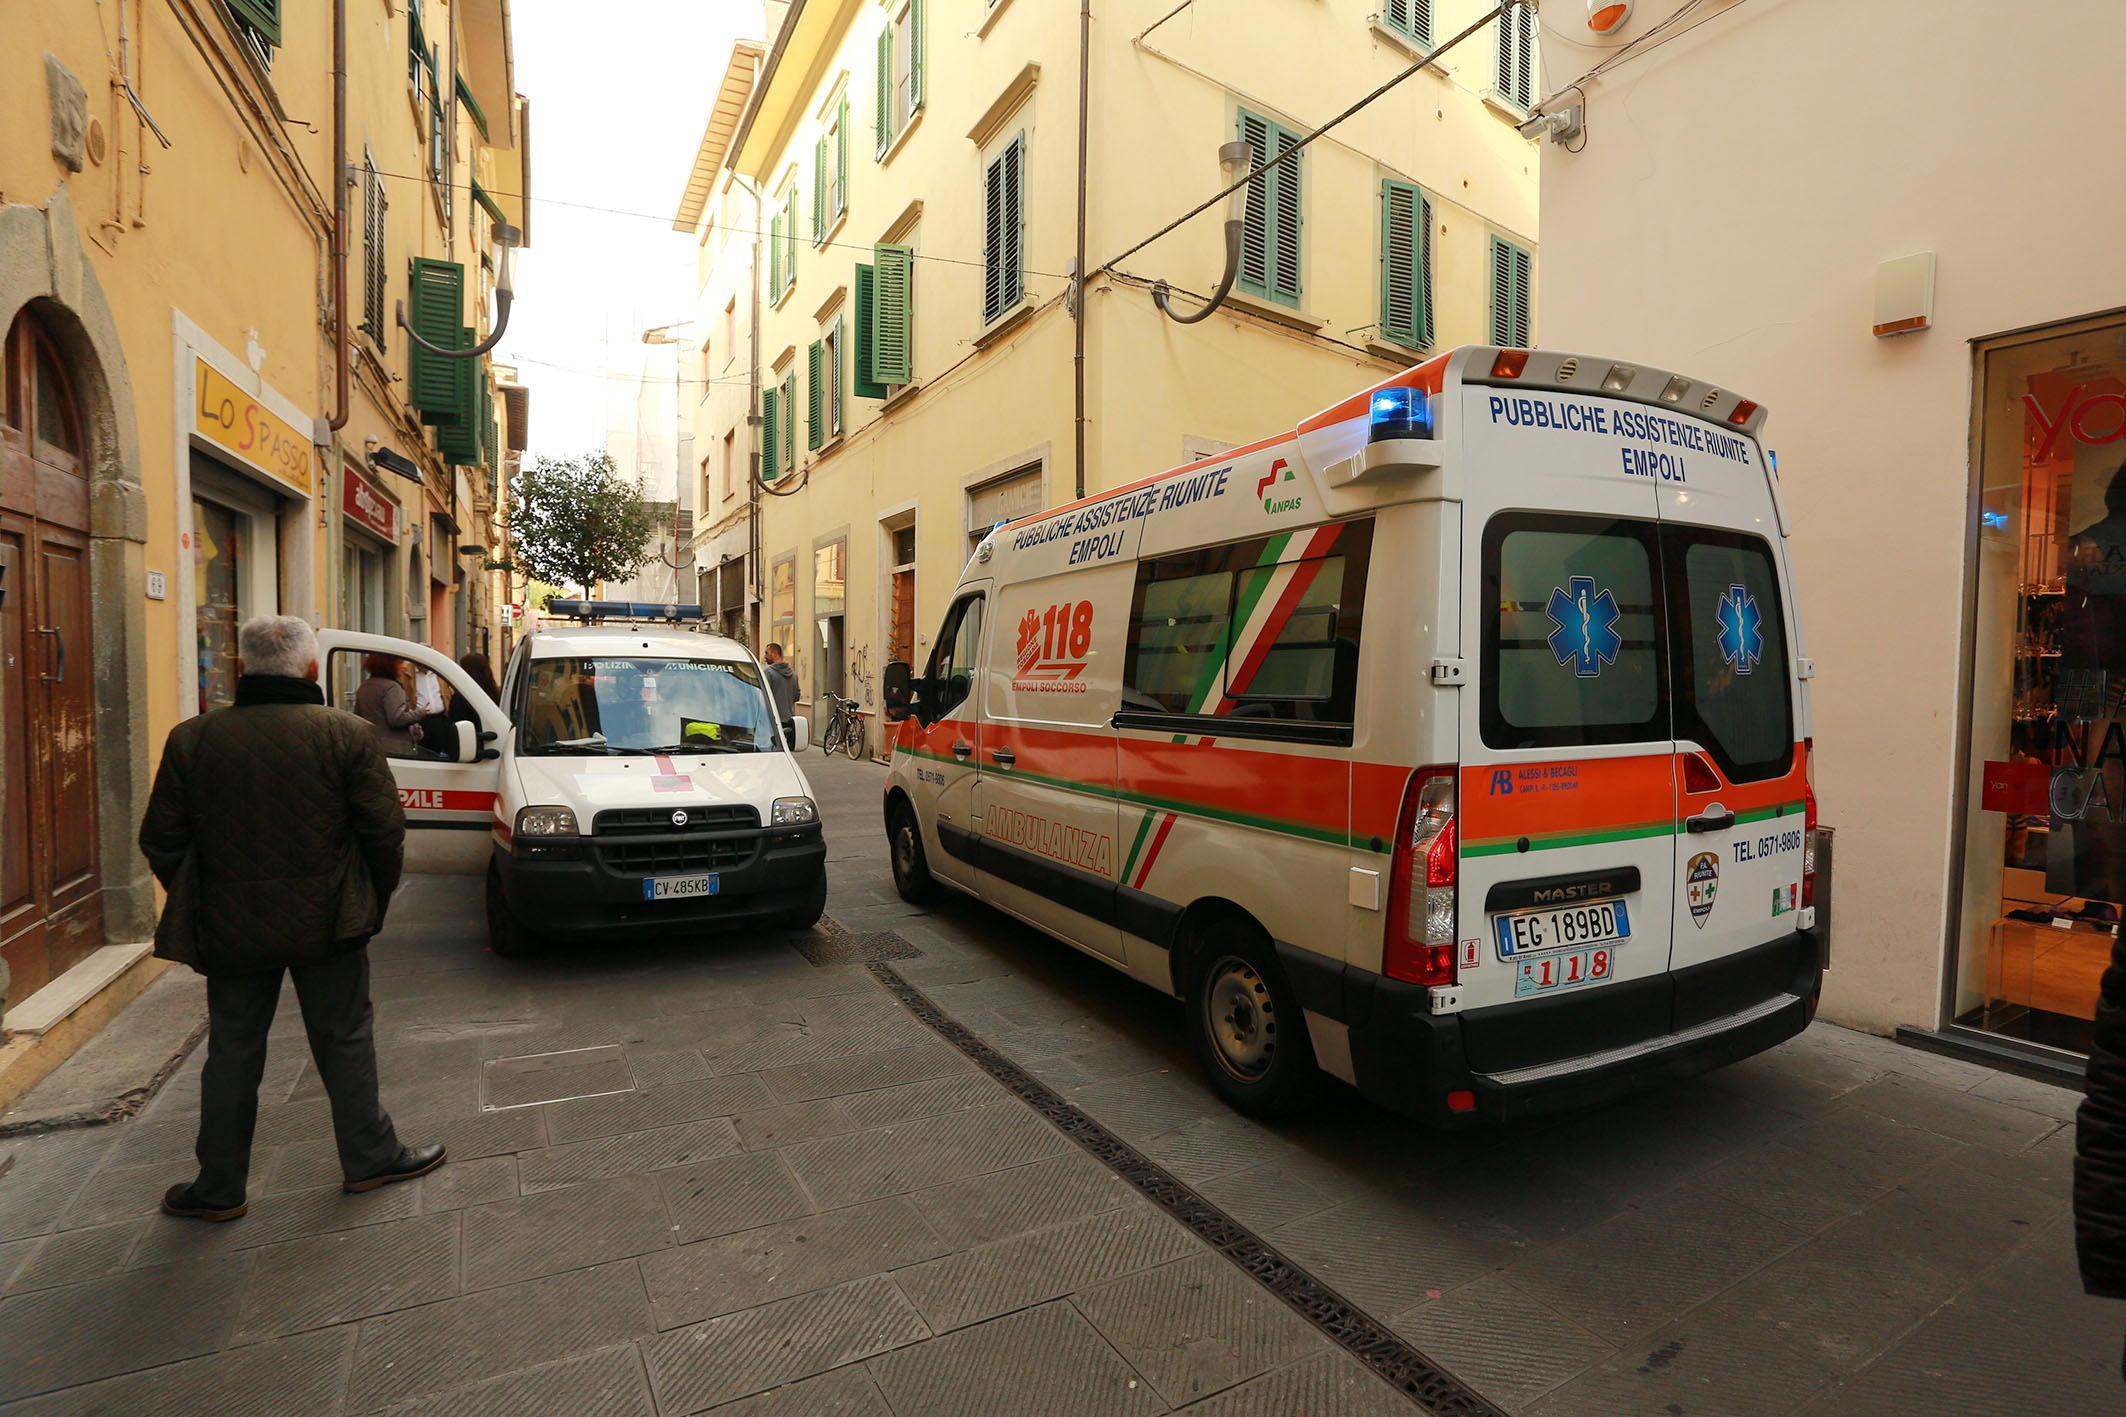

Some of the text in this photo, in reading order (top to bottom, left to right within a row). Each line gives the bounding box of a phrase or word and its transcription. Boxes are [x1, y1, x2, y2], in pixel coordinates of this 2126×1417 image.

[238, 403, 309, 476] SPASSO
[1488, 396, 1749, 465] PUBBLICHE ASSISTENZE RIUNITE
[1621, 447, 1686, 482] EMPOLI
[1012, 467, 1232, 551] PUBBLICHE ASSISTENZE RIUNITE
[1271, 497, 1301, 514] ANPAS
[1068, 530, 1125, 565] EMPOLI
[1042, 600, 1093, 660] 118
[665, 662, 734, 673] MUNICIPALE
[1012, 681, 1087, 694] EMPOLI SOCCORSO
[1518, 767, 1541, 780] ALESSI
[986, 804, 1111, 876] AMBULANZA
[1733, 830, 1801, 863] TEL. 0571-9806
[655, 878, 709, 896] CV 485KB
[1533, 881, 1613, 903] MASTER
[1513, 906, 1615, 950] EG 189BD
